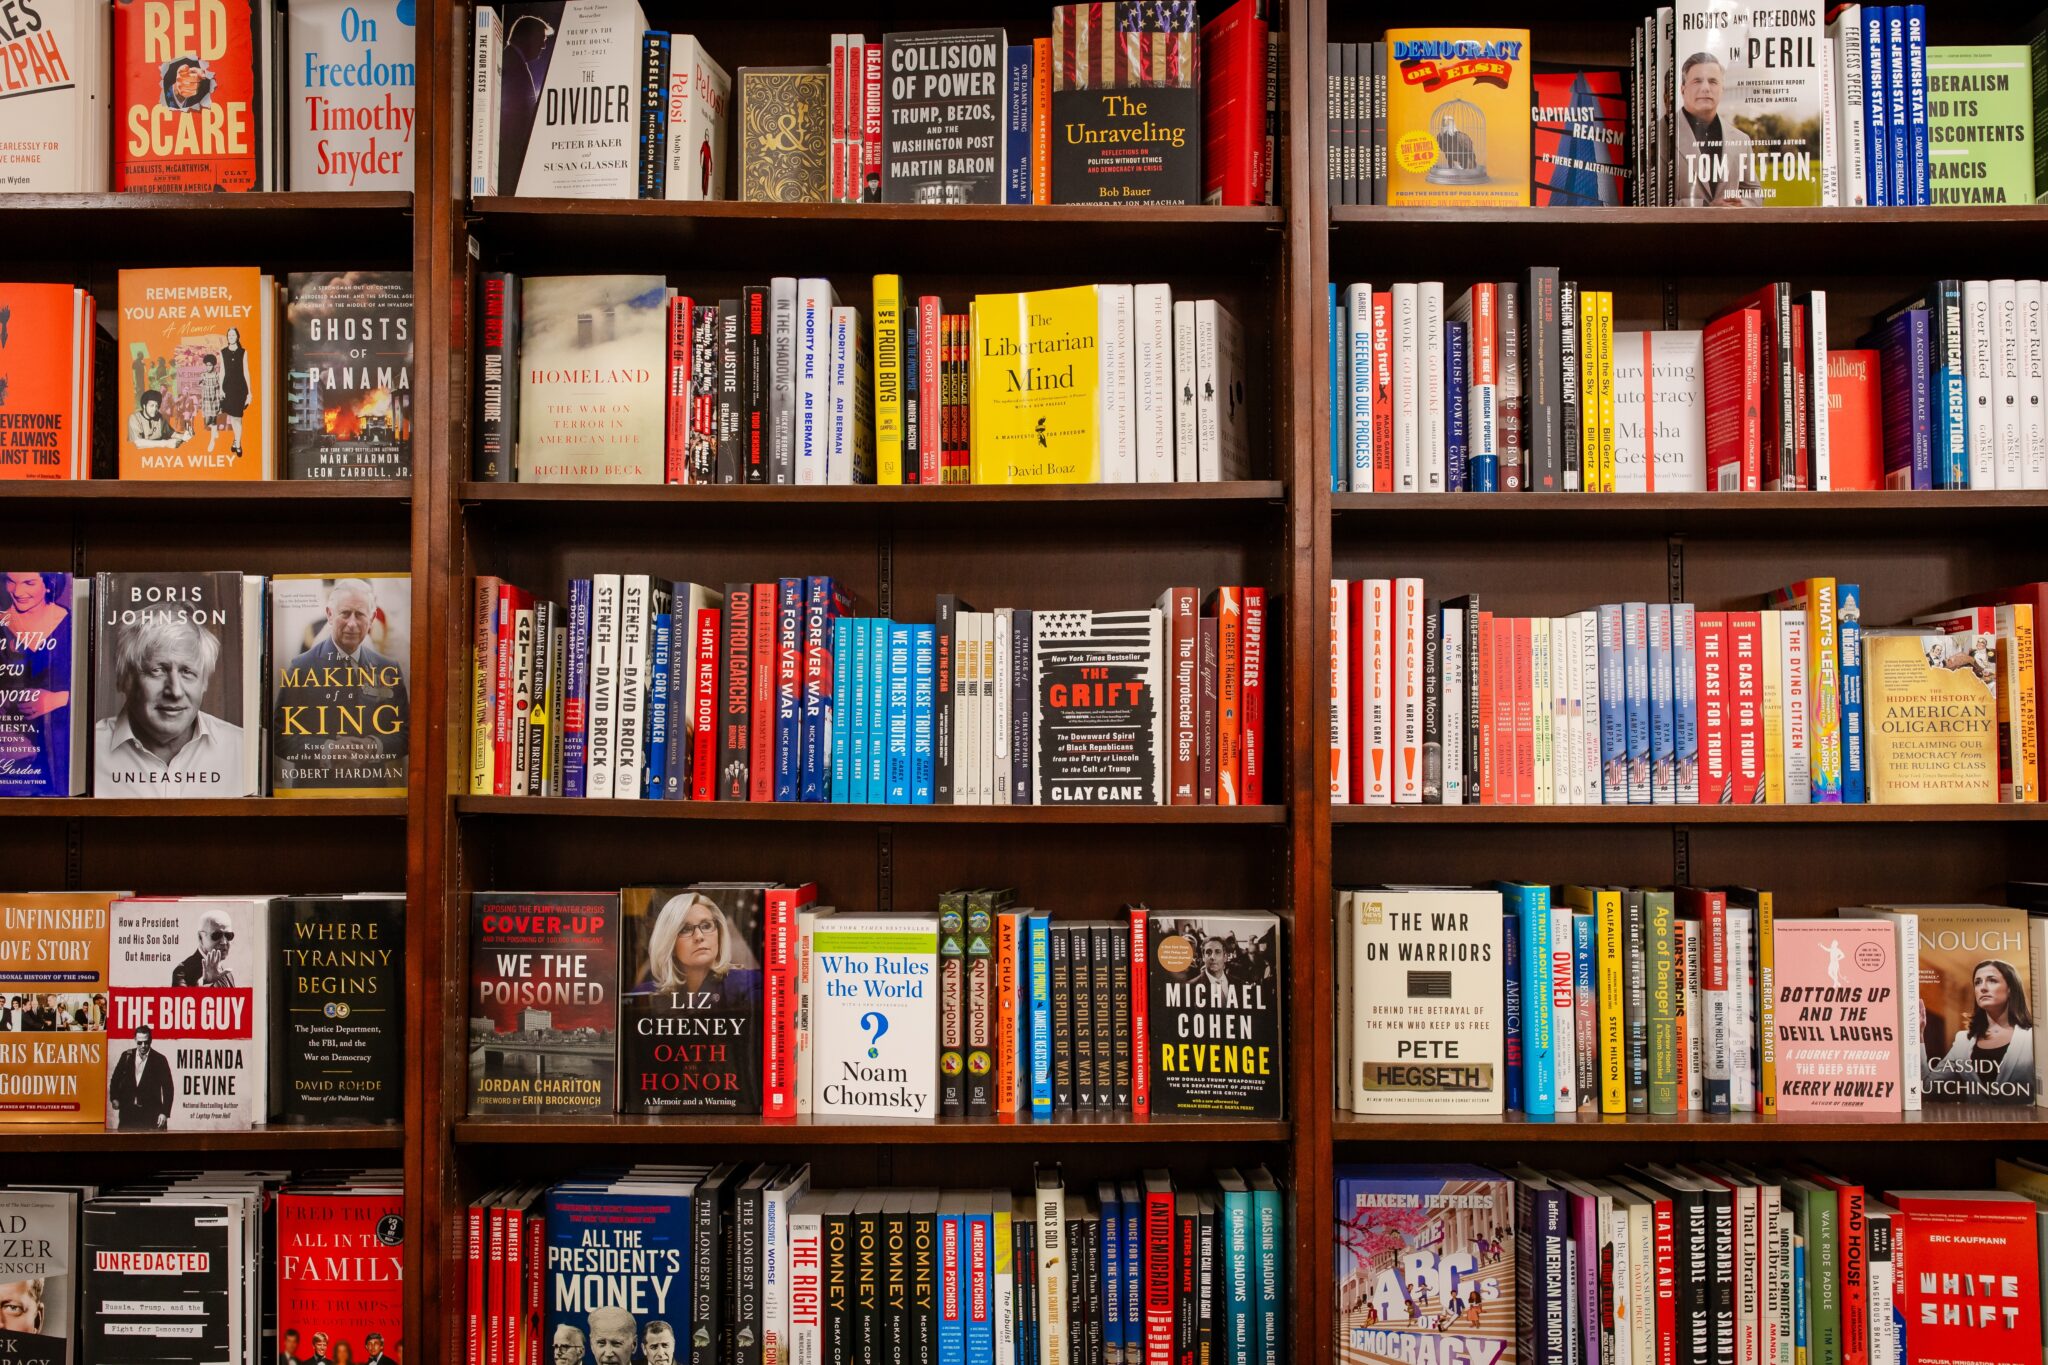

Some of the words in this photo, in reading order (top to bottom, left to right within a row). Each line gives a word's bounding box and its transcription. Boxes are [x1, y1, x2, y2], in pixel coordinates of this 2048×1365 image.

[340, 7, 377, 43] On
[1683, 11, 1728, 31] RIGHTS
[1733, 15, 1748, 25] AND
[1752, 10, 1816, 28] FREEDOMS
[144, 1, 228, 63] RED
[1869, 19, 1881, 44] ONE
[892, 44, 997, 72] COLLISION
[1393, 40, 1522, 61] DEMOCRACY
[1730, 47, 1741, 60] IN
[1747, 37, 1816, 68] PERIL
[304, 49, 415, 88] Freedom
[582, 70, 595, 82] THE
[1407, 67, 1432, 80] OR
[1446, 64, 1504, 79] ELSE
[1870, 46, 1883, 89] JEWISH
[893, 75, 916, 100] OF
[924, 71, 996, 97] POWER
[546, 84, 629, 126] DIVIDER
[891, 107, 943, 125] TRUMP,
[947, 104, 995, 122] BEZOS,
[1102, 96, 1148, 116] The
[1532, 106, 1595, 122] CAPITALIST
[1871, 90, 1884, 127] STATE
[305, 92, 415, 142] Timothy
[128, 102, 248, 157] SCARE
[1066, 122, 1185, 146] Unraveling
[1573, 124, 1624, 146] REALISM
[551, 139, 584, 150] PETER
[586, 137, 622, 149] BAKER
[892, 137, 963, 154] WASHINGTON
[965, 135, 994, 149] POST
[316, 136, 403, 186] Snyder
[543, 160, 577, 172] SUSAN
[580, 159, 628, 170] GLASSER
[891, 159, 943, 178] MARTIN
[946, 156, 995, 175] BARON
[1685, 152, 1728, 183] TOM
[1739, 152, 1816, 183] FITTON,
[1099, 186, 1116, 197] Bob
[1118, 187, 1151, 197] Bauer
[146, 286, 232, 302] REMEMBER,
[124, 306, 154, 320] YOU
[157, 306, 186, 319] ARE
[190, 305, 201, 318] A
[204, 304, 252, 318] WILEY
[1027, 314, 1052, 327] The
[310, 318, 408, 341] GHOSTS
[349, 348, 367, 359] OF
[983, 333, 1095, 358] Libertarian
[1355, 332, 1370, 393] DEFENDING
[309, 367, 410, 391] PANAMA
[531, 369, 650, 384] HOMELAND
[1006, 366, 1075, 393] Mind
[1355, 396, 1370, 417] DUE
[1356, 420, 1370, 469] PROCESS
[141, 455, 184, 469] MAYA
[187, 454, 237, 468] WILEY
[534, 465, 597, 476] RICHARD
[604, 465, 642, 475] BECK
[1007, 464, 1042, 478] David
[1045, 463, 1076, 476] Boaz
[131, 586, 202, 602] BORIS
[107, 610, 227, 625] JOHNSON
[598, 587, 612, 643] STENCH
[1427, 614, 1437, 639] Who
[1180, 637, 1195, 658] The
[1405, 585, 1415, 697] OUTRAGED
[1705, 633, 1718, 659] THE
[516, 616, 529, 694] ANTIFA
[729, 591, 748, 714] CONTROLIGARCHS
[1426, 641, 1436, 671] Owns
[280, 666, 401, 688] MAKING
[1081, 667, 1108, 680] THE
[1426, 672, 1435, 693] the
[1705, 663, 1719, 697] CASE
[596, 666, 610, 712] DAVID
[1050, 682, 1144, 707] GRIFT
[1180, 661, 1194, 728] Unprotected
[281, 705, 403, 735] KING
[1426, 696, 1437, 735] Moon?
[1707, 701, 1720, 728] FOR
[1886, 705, 1987, 719] AMERICAN
[1057, 733, 1069, 741] The
[1071, 732, 1109, 741] Downward
[1112, 731, 1135, 741] Spiral
[1881, 719, 1992, 734] OLIGARCHY
[594, 718, 608, 768] BROCK
[1180, 731, 1192, 762] Class
[1708, 732, 1722, 779] TRUMP
[112, 772, 221, 783] UNLEASHED
[281, 767, 329, 779] ROBERT
[334, 767, 403, 778] HARDMAN
[1051, 787, 1093, 800] CLAY
[1098, 786, 1142, 800] CANE
[1886, 780, 1920, 789] THOM
[1923, 779, 1990, 789] HARTMANN
[295, 922, 378, 940] WHERE
[482, 916, 605, 934] COVER-UP
[1389, 912, 1422, 931] THE
[1431, 913, 1469, 931] WAR
[283, 949, 392, 967] TYRANNY
[1367, 942, 1389, 961] ON
[1399, 942, 1491, 962] WARRIORS
[497, 954, 531, 978] WE
[540, 954, 587, 978] THE
[821, 956, 870, 976] Who
[875, 954, 929, 975] Rules
[298, 976, 377, 994] BEGINS
[480, 982, 603, 1005] POISONED
[827, 980, 857, 998] the
[862, 978, 923, 998] World
[1780, 987, 1862, 1003] BOTTOMS
[1867, 987, 1890, 1002] UP
[671, 991, 712, 1010] LIZ
[1165, 983, 1266, 1009] MICHAEL
[115, 995, 159, 1031] THE
[163, 996, 196, 1030] BIG
[199, 996, 245, 1030] GUY
[1799, 1007, 1833, 1021] AND
[1840, 1007, 1867, 1021] THE
[637, 1018, 746, 1036] CHENEY
[1177, 1013, 1253, 1040] COHEN
[1779, 1025, 1825, 1041] DEVIL
[1830, 1026, 1893, 1041] LAUGHS
[177, 1048, 243, 1070] MIRANDA
[654, 1044, 726, 1063] OATH
[1161, 1044, 1270, 1075] REVENGE
[1397, 1040, 1459, 1059] PETE
[841, 1061, 908, 1083] Noam
[1376, 1066, 1479, 1086] HEGSETH
[1928, 1057, 2004, 1074] CASSIDY
[183, 1075, 236, 1096] DEVINE
[295, 1081, 332, 1091] DAVID
[478, 1079, 530, 1094] JORDAN
[534, 1079, 601, 1093] CHARITON
[640, 1073, 739, 1091] HONOR
[1782, 1081, 1830, 1096] KERRY
[1833, 1081, 1894, 1098] HOWLEY
[823, 1085, 926, 1112] Chomsky
[1356, 1194, 1418, 1208] HAKEEM
[1423, 1194, 1494, 1209] JEFFRIES
[582, 1229, 609, 1248] ALL
[614, 1231, 642, 1247] THE
[1930, 1235, 1950, 1244] ERIC
[1953, 1235, 2007, 1245] KAUFMANN
[98, 1253, 209, 1271] UNREDACTED
[548, 1247, 679, 1273] PRESIDENT'S
[830, 1222, 844, 1311] ROMNEY
[555, 1274, 672, 1314] MONEY
[1920, 1272, 2018, 1298] WHITE
[1921, 1303, 2019, 1329] SHIFT
